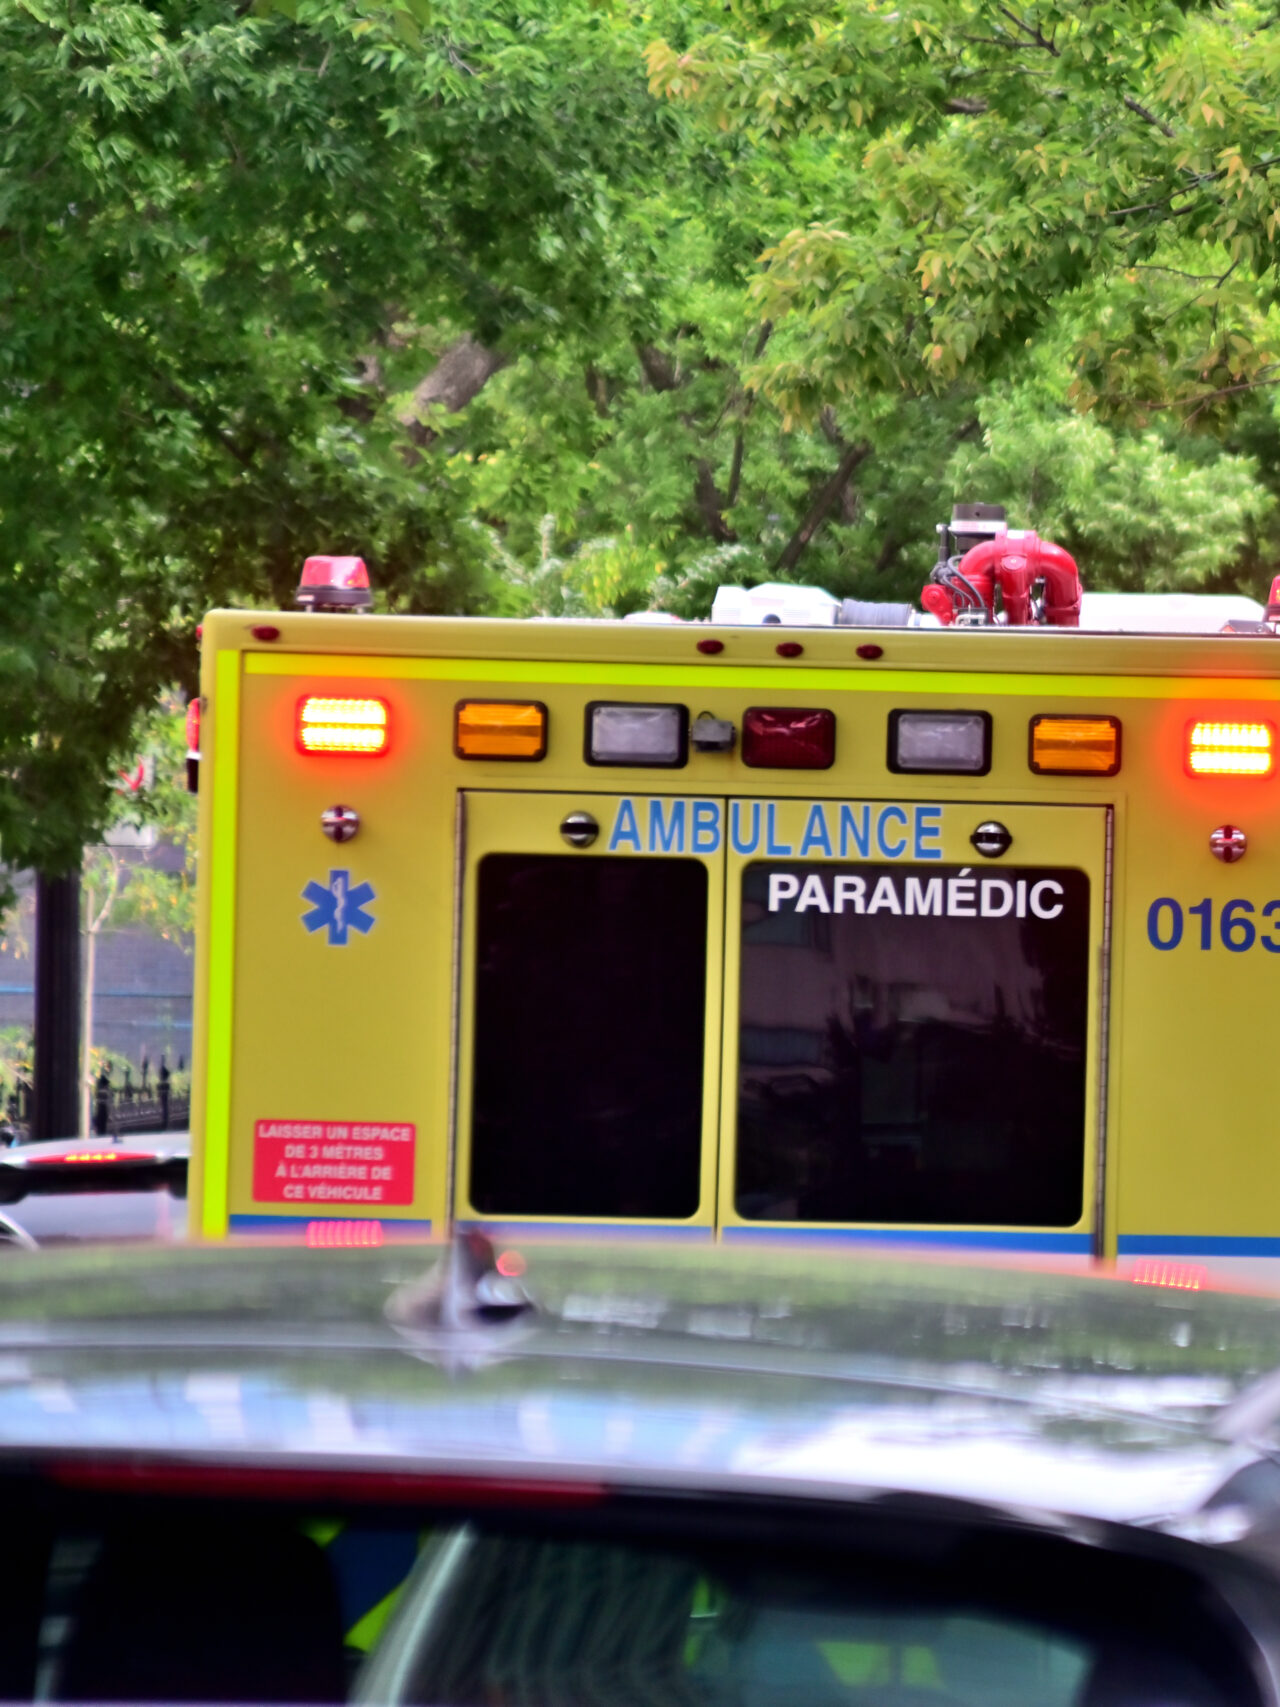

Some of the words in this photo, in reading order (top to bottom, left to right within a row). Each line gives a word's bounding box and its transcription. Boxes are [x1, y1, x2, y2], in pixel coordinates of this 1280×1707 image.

[608, 799, 942, 859] AMBULANCE
[768, 867, 1064, 919] PARAMÉDIC
[258, 1124, 323, 1139] LAISSER
[326, 1125, 348, 1139] UN
[352, 1127, 412, 1142] ESPACE
[284, 1144, 306, 1159] DE
[309, 1145, 319, 1159] 3
[275, 1160, 287, 1178] À
[371, 1166, 393, 1181] DE
[283, 1184, 305, 1199] CE
[308, 1182, 383, 1201] VÉHICULE
